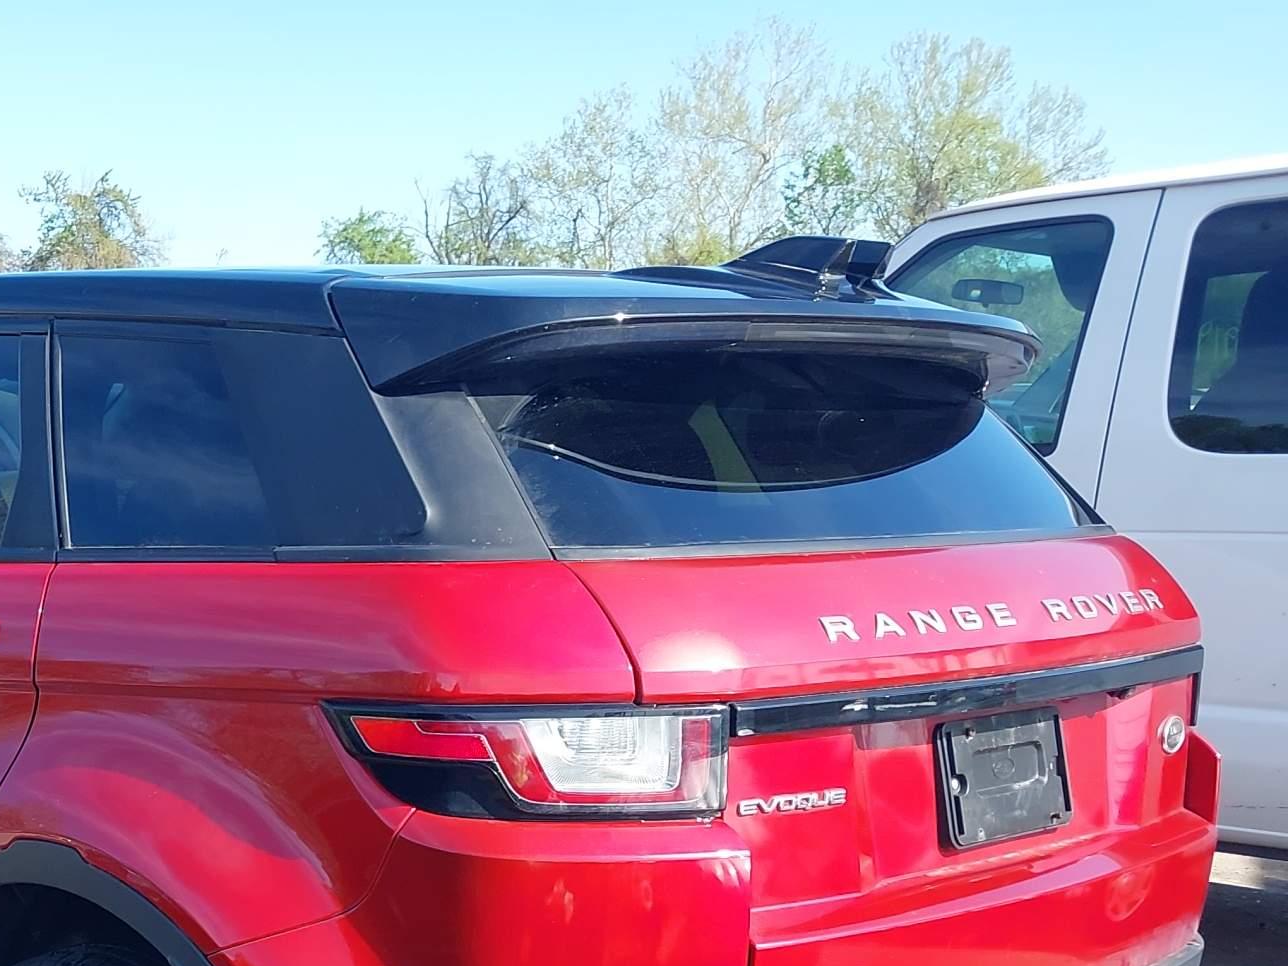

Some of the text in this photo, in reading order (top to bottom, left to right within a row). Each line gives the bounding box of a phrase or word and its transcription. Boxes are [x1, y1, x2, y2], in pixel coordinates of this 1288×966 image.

[819, 588, 1164, 643] RANGE ROVER
[737, 787, 847, 816] EVOQUE
